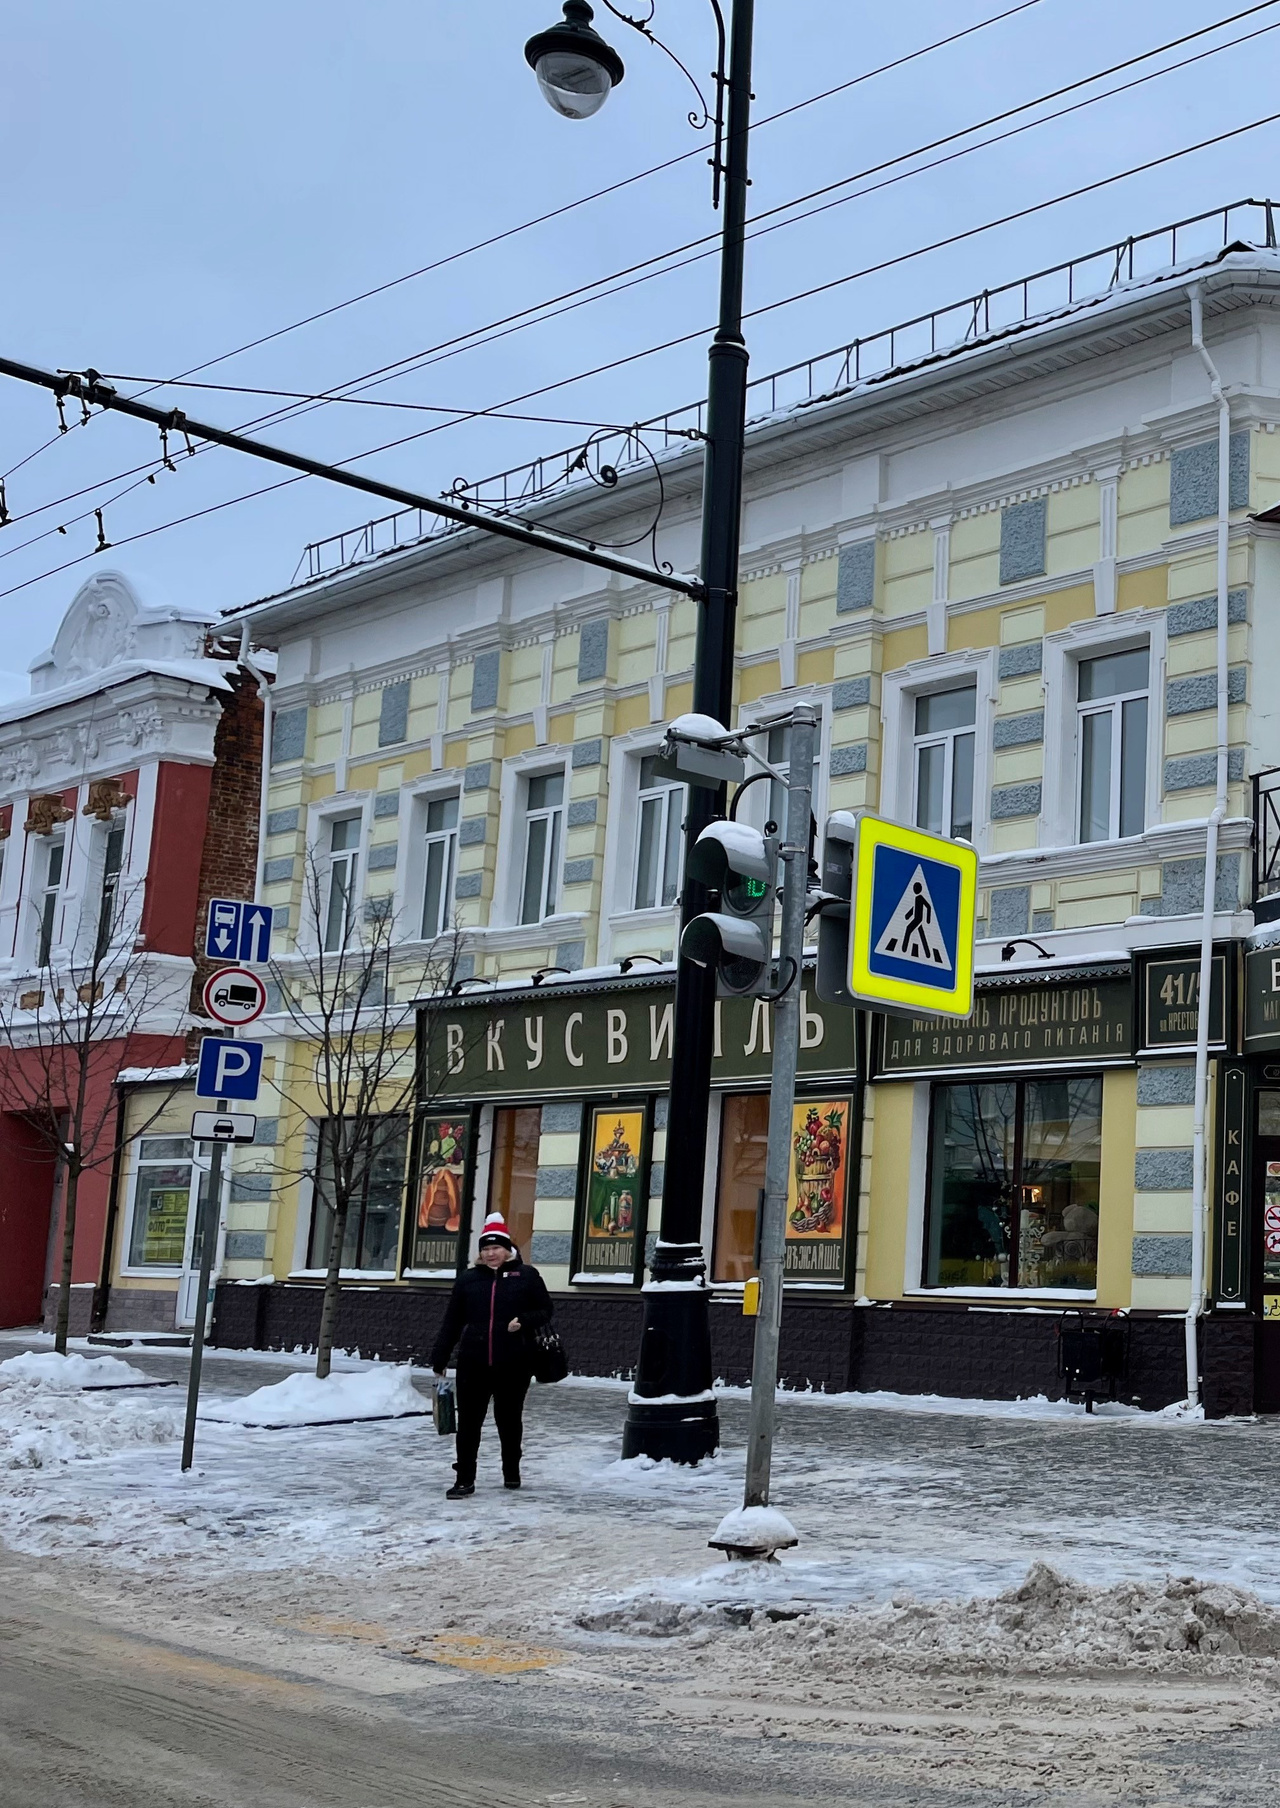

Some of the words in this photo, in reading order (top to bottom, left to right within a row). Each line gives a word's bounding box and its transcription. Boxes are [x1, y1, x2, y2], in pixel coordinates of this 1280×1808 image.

[891, 1038, 922, 1059] ДЛЯ
[932, 1031, 1031, 1056] ЗДОРОВАГО
[1225, 1129, 1240, 1237] КАФЕ
